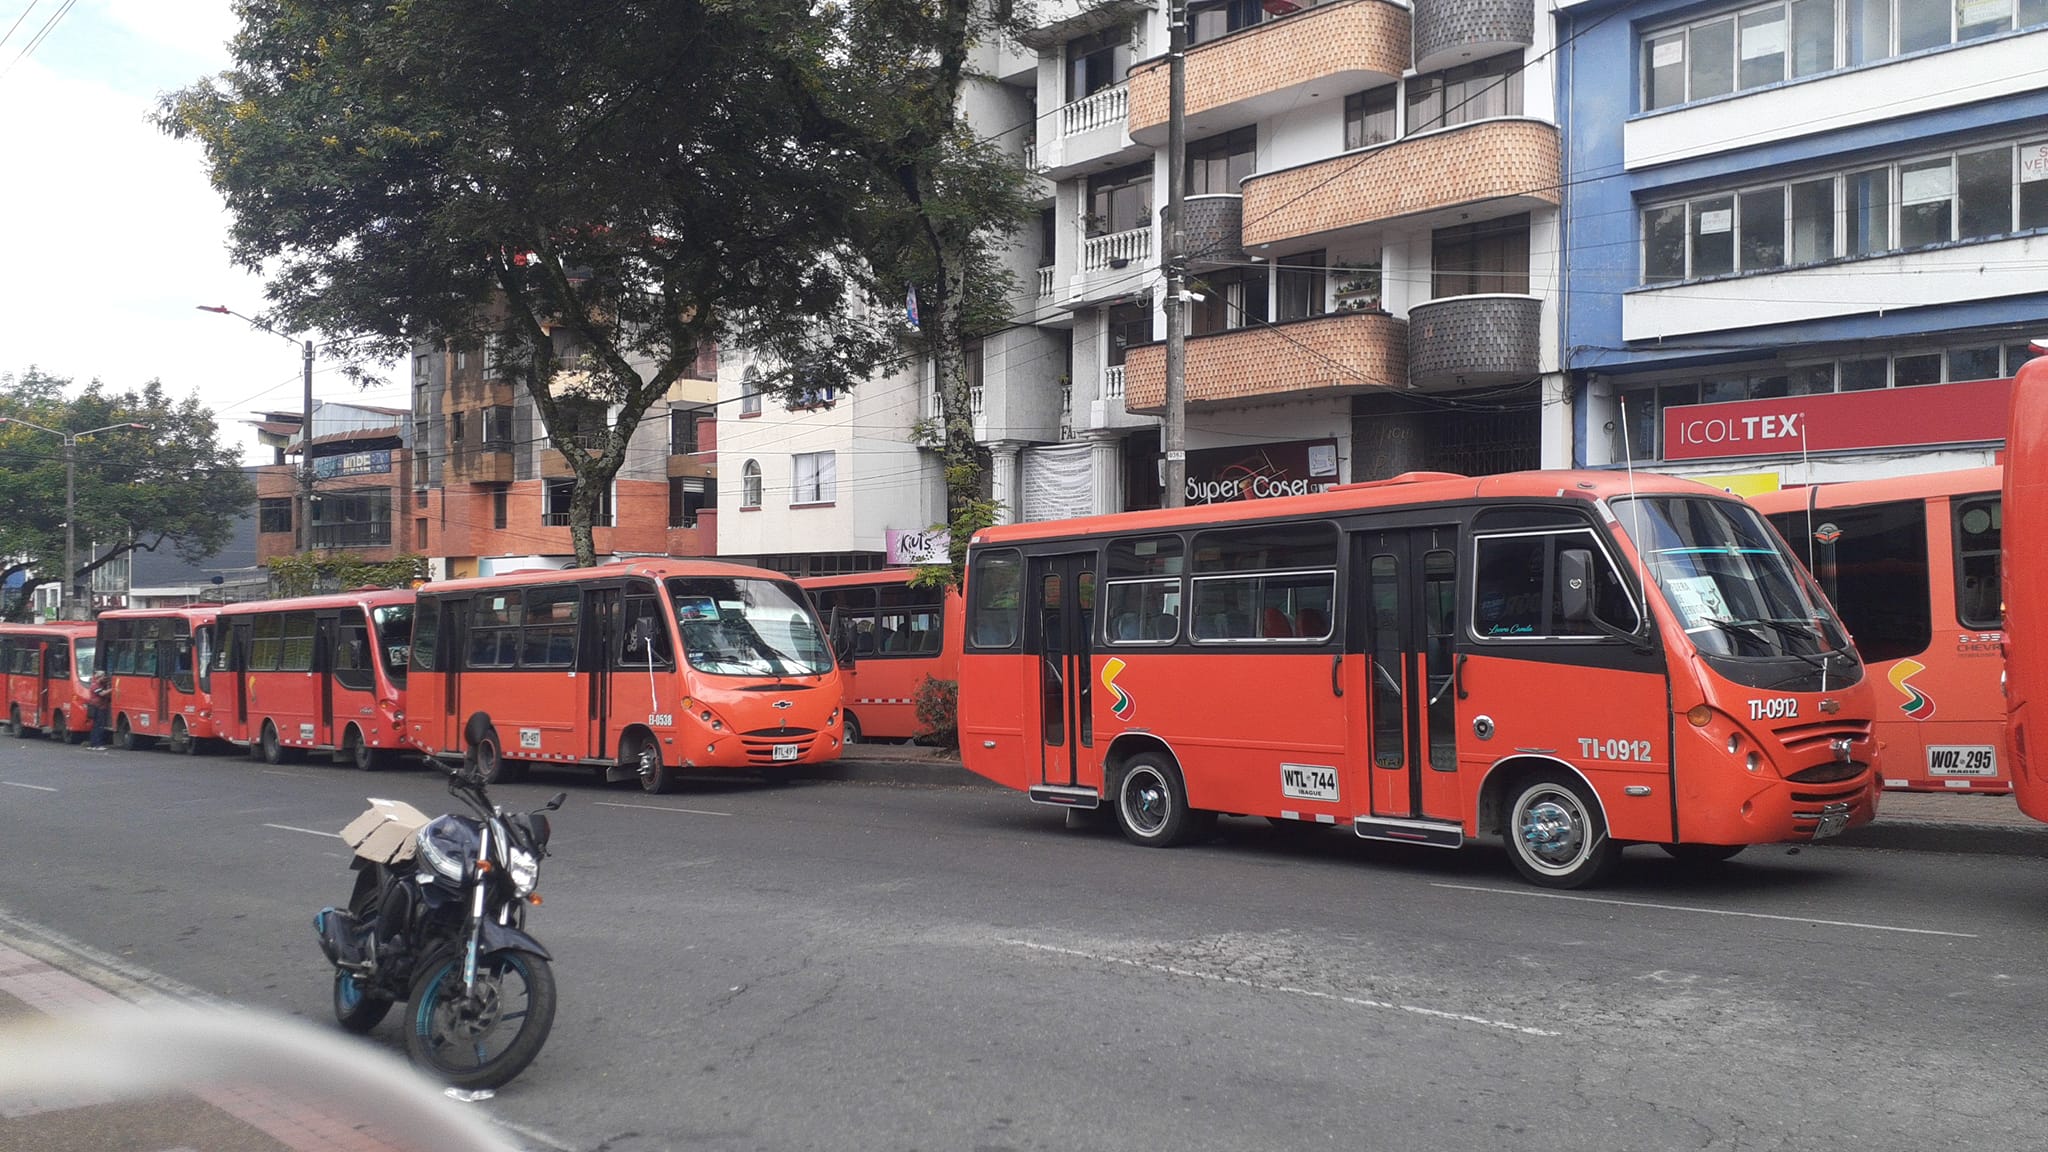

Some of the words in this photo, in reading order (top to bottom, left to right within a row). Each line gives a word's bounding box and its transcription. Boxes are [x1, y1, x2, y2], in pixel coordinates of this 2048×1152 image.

[1681, 413, 1799, 445] ICOLTEX
[1185, 475, 1240, 505] Super
[1957, 643, 2001, 652] CHEVR
[1747, 697, 1799, 720] TI-0912
[1577, 737, 1653, 762] TI-0912
